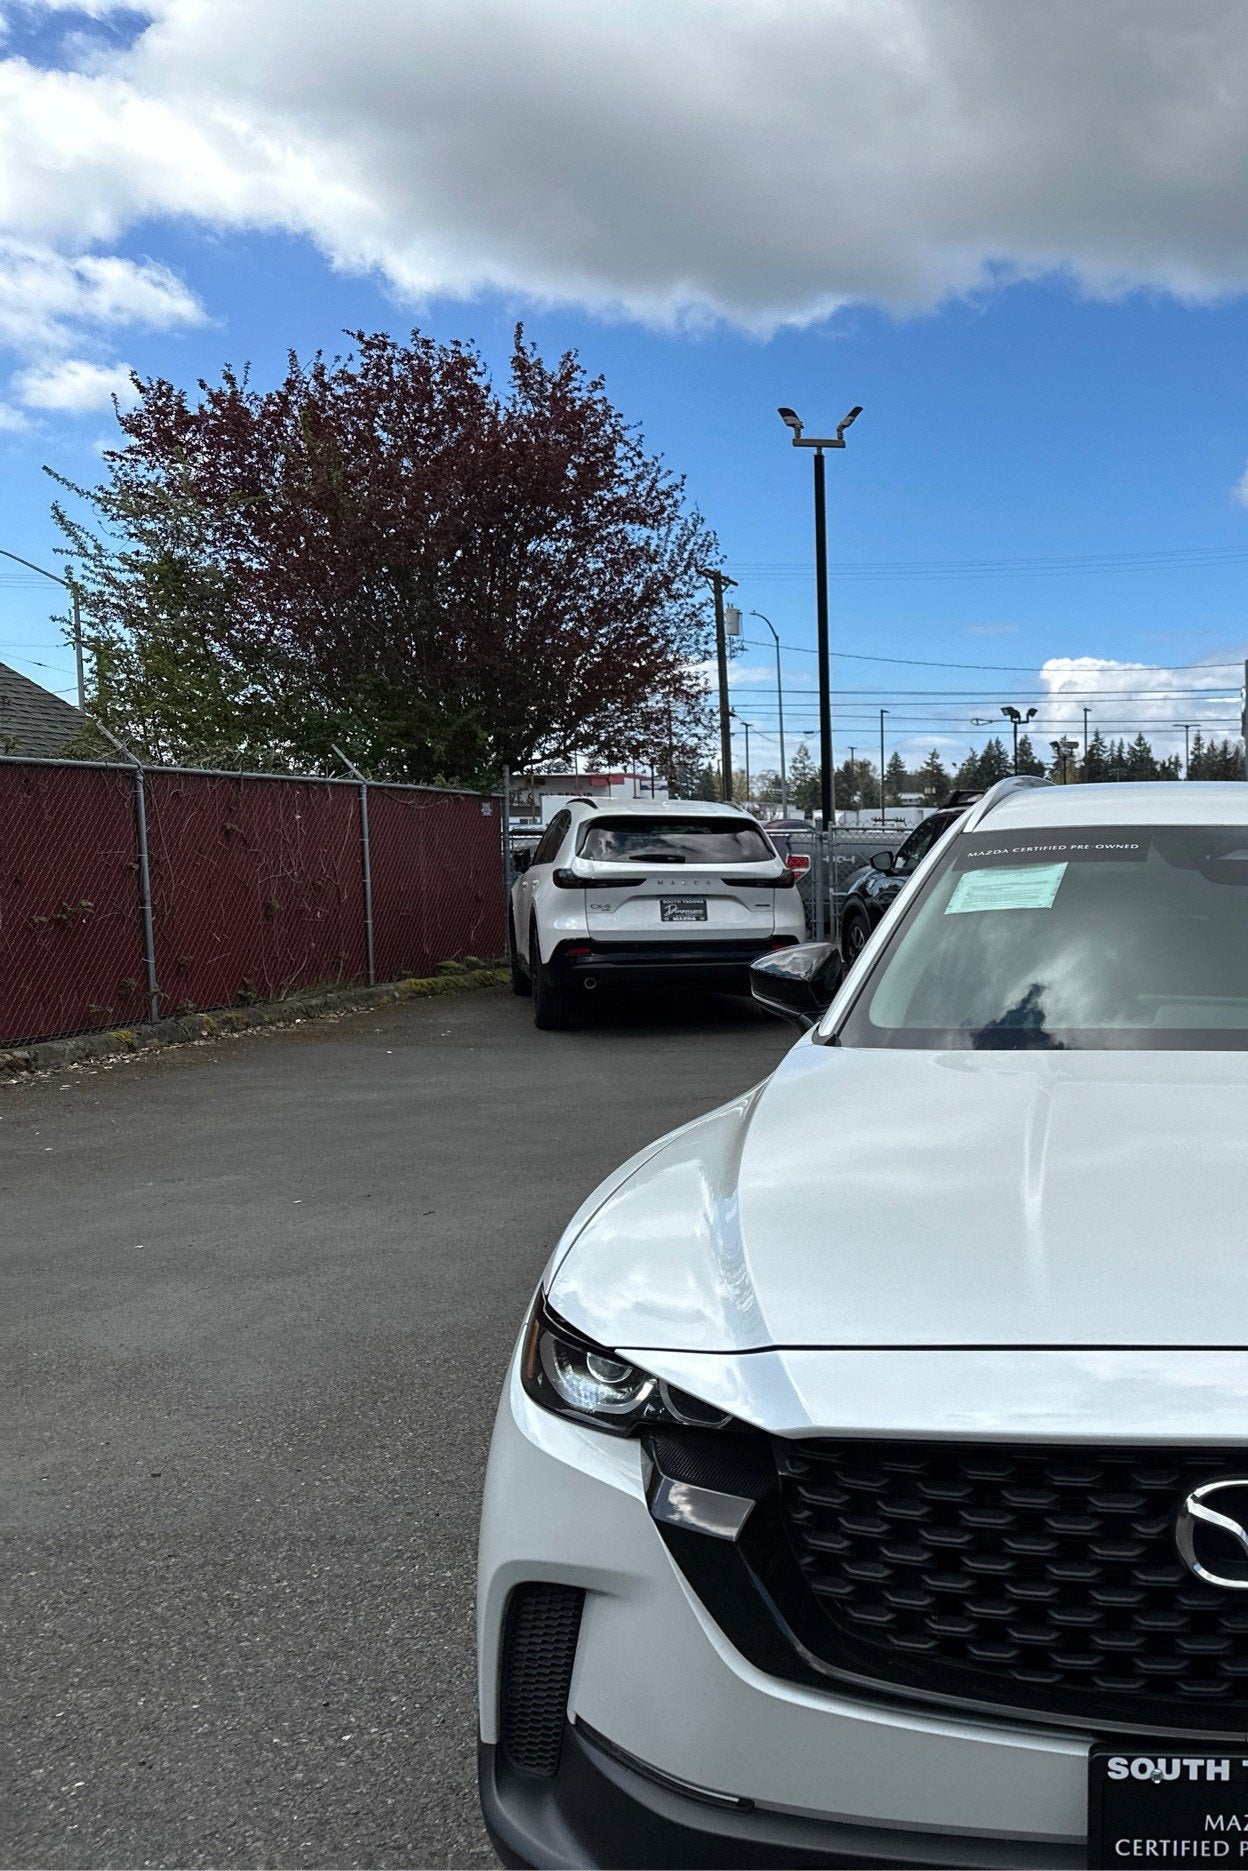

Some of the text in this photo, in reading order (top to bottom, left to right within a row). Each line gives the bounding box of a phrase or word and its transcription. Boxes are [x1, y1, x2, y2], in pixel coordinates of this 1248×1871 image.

[967, 848, 1009, 858] MAZDA
[1012, 845, 1067, 853] CERTIFIED
[1107, 1757, 1230, 1782] SOUTH
[1115, 1839, 1230, 1858] CERTIFIED
